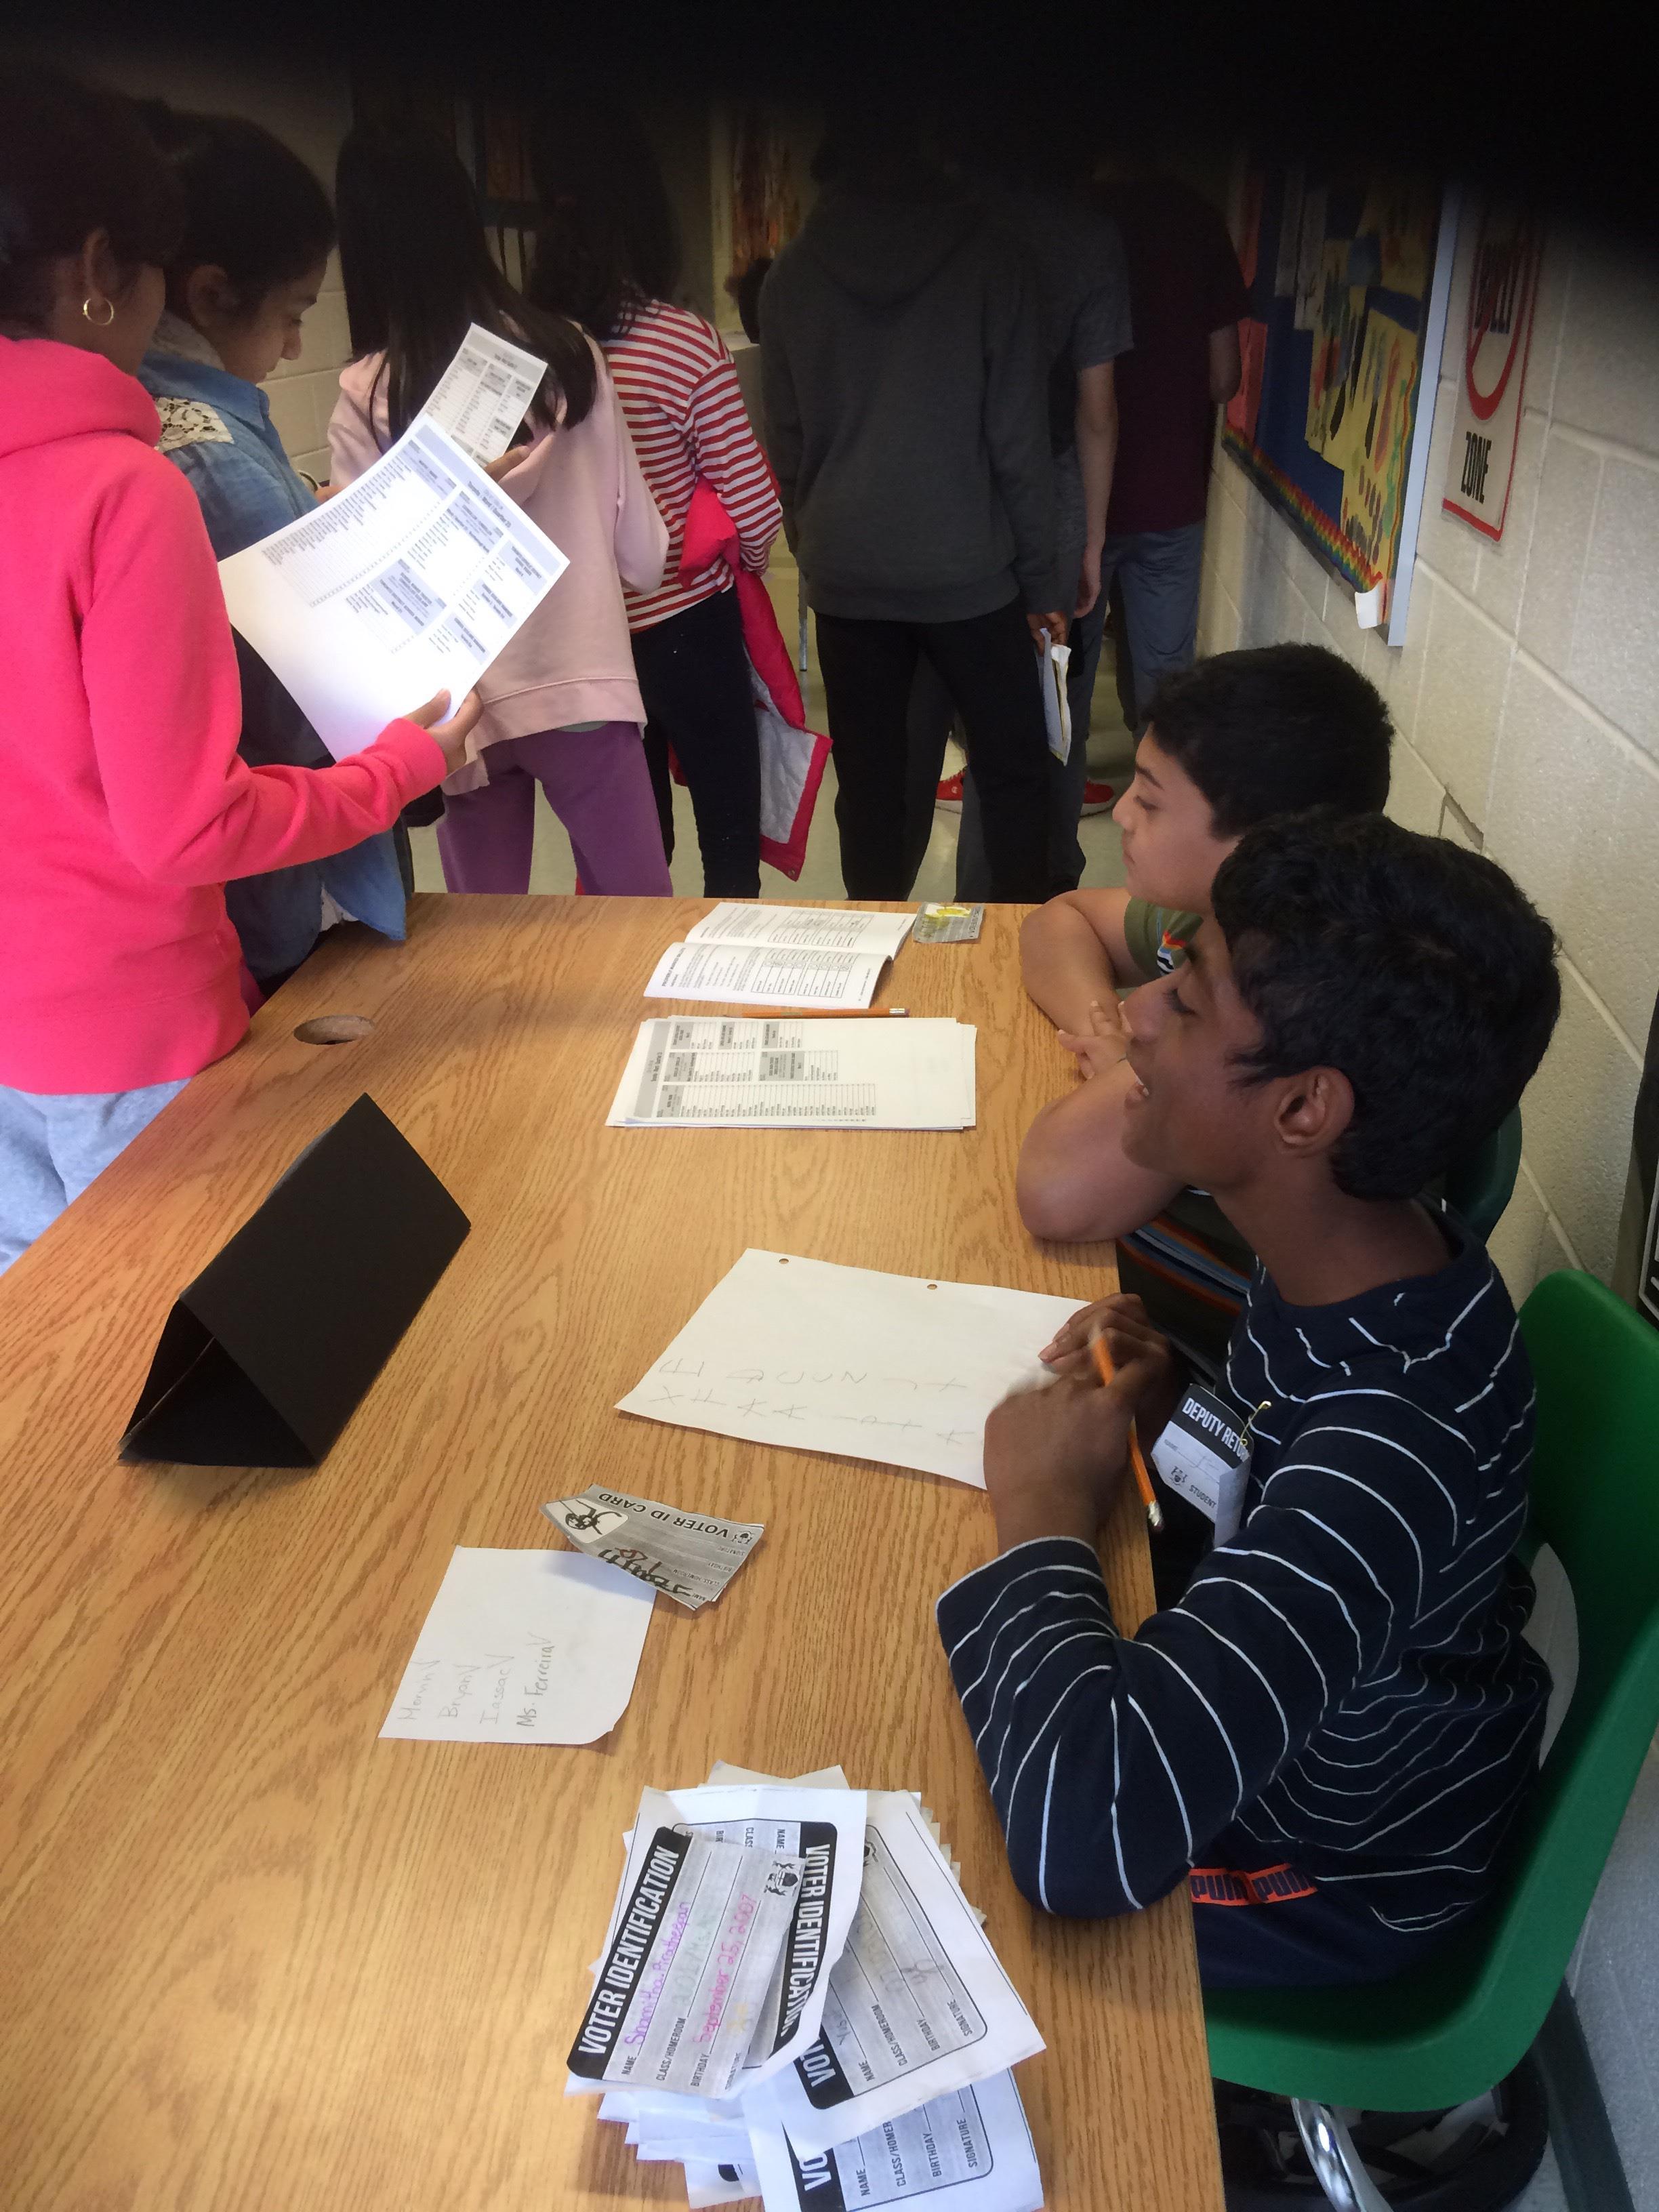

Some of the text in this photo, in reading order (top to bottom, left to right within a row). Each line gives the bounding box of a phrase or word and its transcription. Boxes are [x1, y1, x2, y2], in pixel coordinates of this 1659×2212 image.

[1461, 431, 1492, 504] ZONE
[1182, 1397, 1225, 1437] DEPUTY
[598, 1493, 729, 1538] VOTER ID CARD
[1189, 1484, 1217, 1509] STUDENT
[516, 1702, 537, 1727] Ms.
[775, 1828, 786, 1849] NAME
[801, 1843, 831, 1898] VOTER
[1191, 1875, 1248, 1900] PUM
[729, 1894, 758, 1934] 2007
[579, 1845, 679, 2054] VOTER IDENTIFICATION
[871, 2003, 908, 2066] CLASS/HOMEROOM
[916, 2018, 941, 2051] BIRTHDAY
[947, 1998, 973, 2036] SIGNATURE
[622, 2055, 636, 2076] NAME
[656, 2017, 687, 2081] CLASS/HOMEROOM
[800, 2040, 837, 2087] VOT
[691, 2053, 712, 2087] BIRTHDAY
[858, 2061, 876, 2082] NAME
[882, 2120, 906, 2188] CLASS/HOMER
[922, 2133, 942, 2178] BIRTHDAY
[956, 2117, 978, 2169] SIGNATURE
[856, 2168, 870, 2197] NAME
